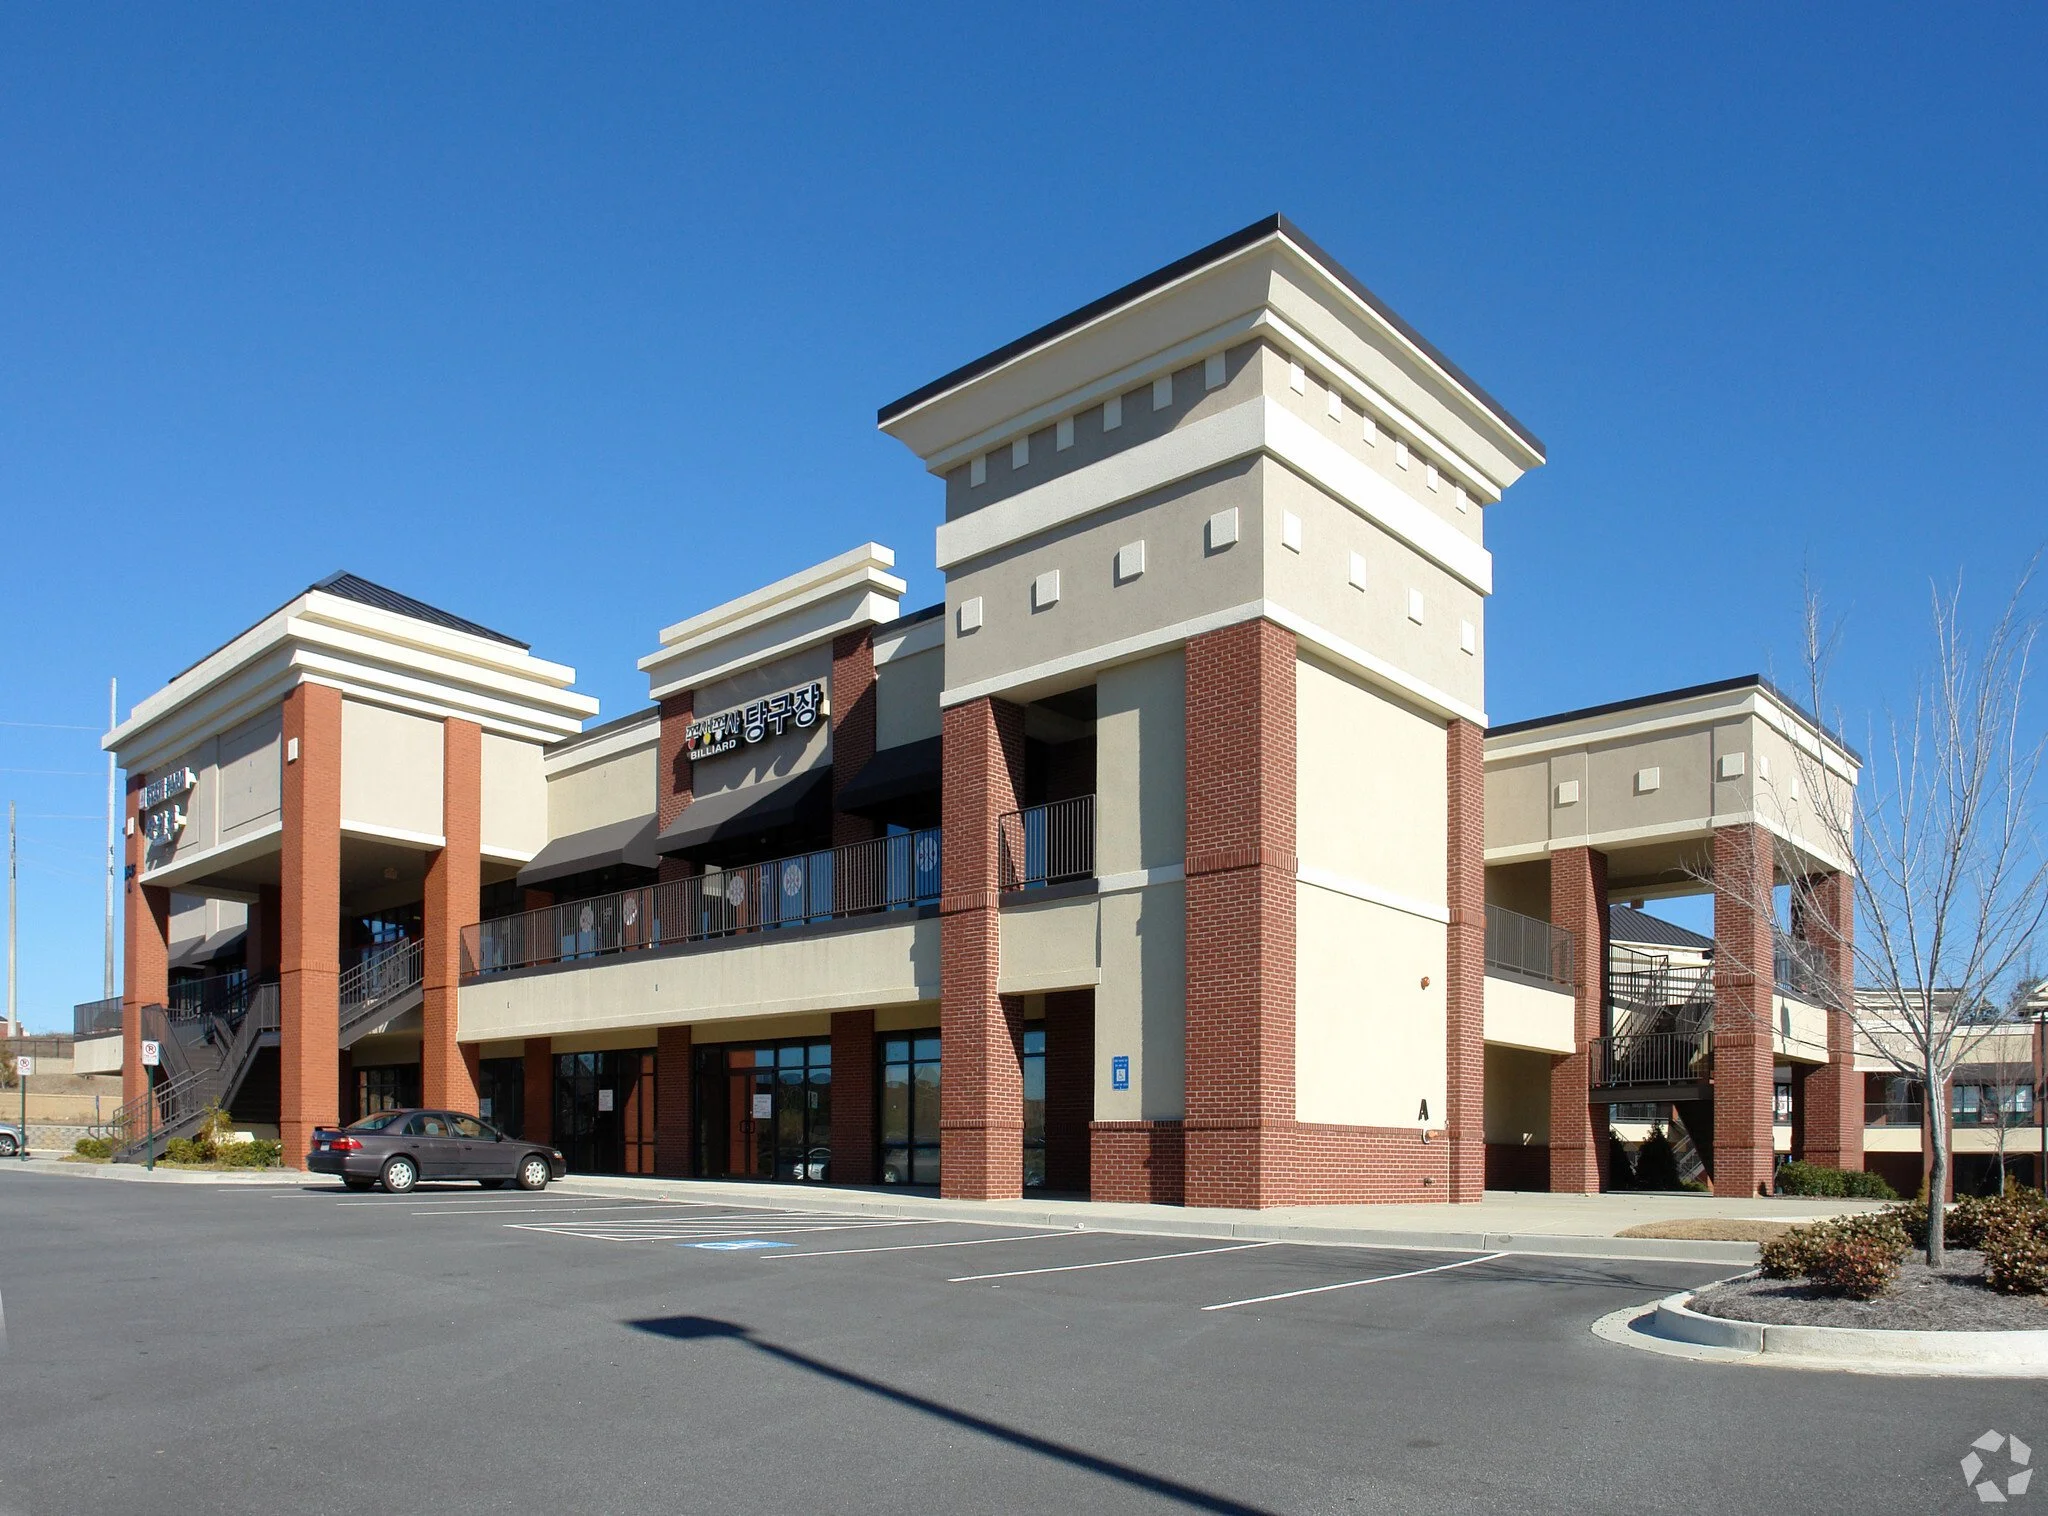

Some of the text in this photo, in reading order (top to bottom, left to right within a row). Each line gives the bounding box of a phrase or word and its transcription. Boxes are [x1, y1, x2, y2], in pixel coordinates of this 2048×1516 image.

[744, 682, 820, 743] 당구장
[691, 739, 736, 760] BILLIARD
[1418, 1099, 1430, 1121] A
